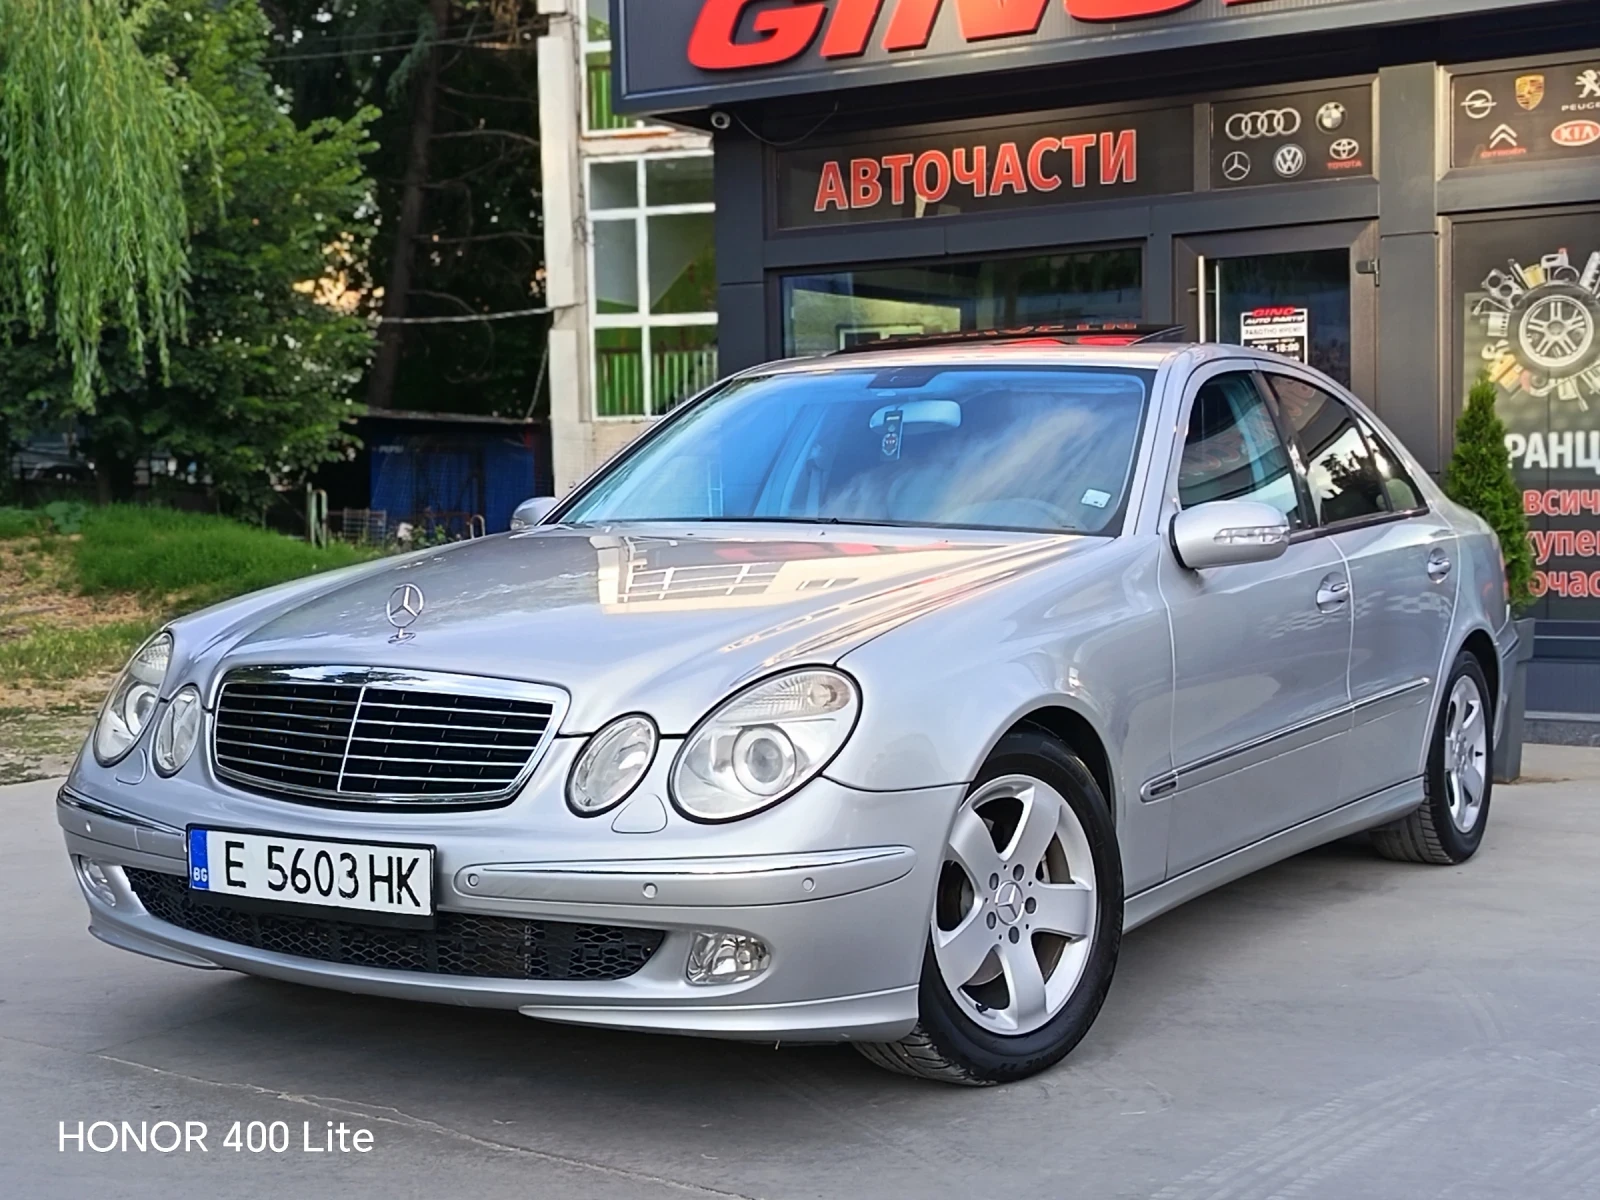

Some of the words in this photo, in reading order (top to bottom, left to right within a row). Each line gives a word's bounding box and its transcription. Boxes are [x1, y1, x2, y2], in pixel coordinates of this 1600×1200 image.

[1560, 125, 1595, 141] KIA
[814, 129, 1137, 212] АВТОЧАСТИ
[1327, 159, 1362, 170] TOYOTA
[1244, 317, 1271, 325] AUTO
[193, 867, 208, 883] BG
[225, 841, 247, 889] E
[267, 845, 359, 900] 5603
[368, 854, 421, 907] HK
